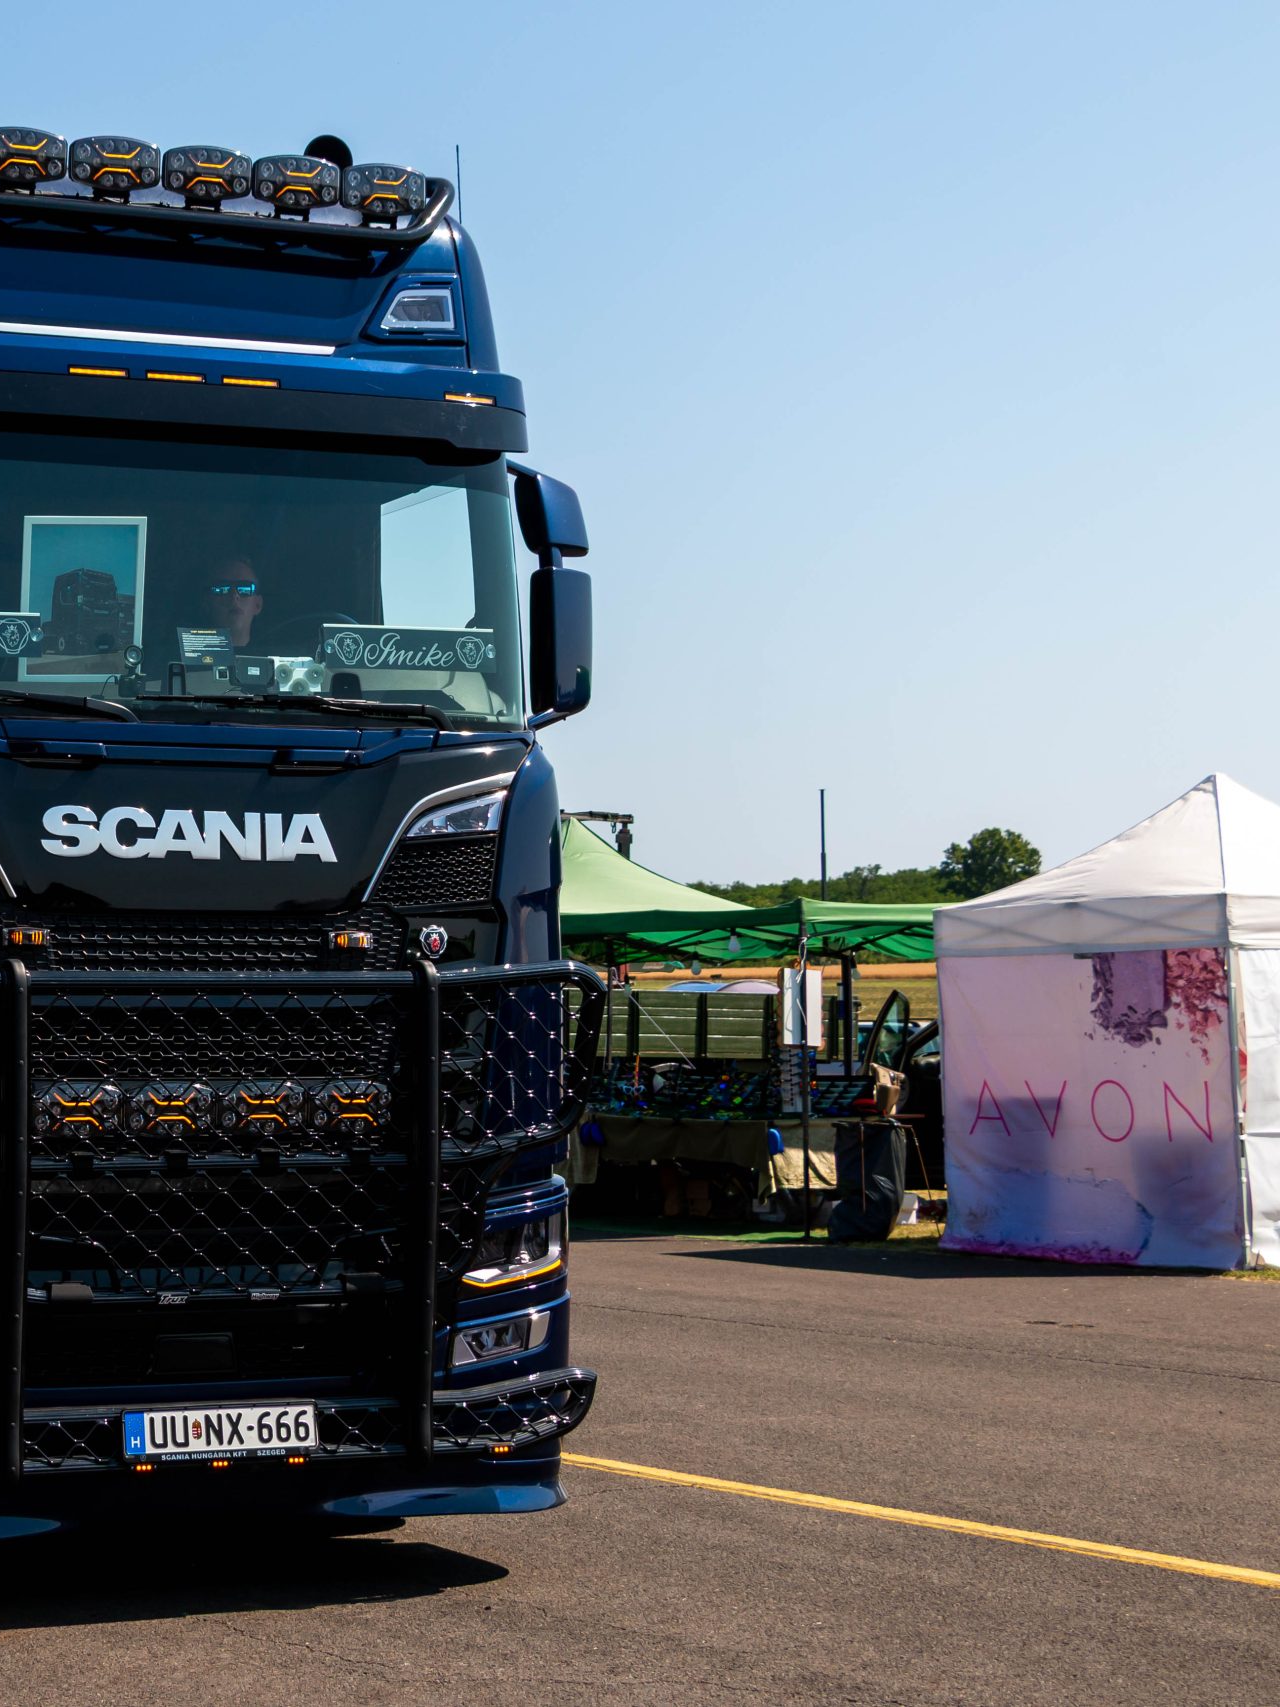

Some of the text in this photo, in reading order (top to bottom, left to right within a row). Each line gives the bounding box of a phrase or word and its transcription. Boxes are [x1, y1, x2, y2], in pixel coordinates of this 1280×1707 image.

[40, 804, 338, 863] SCANIA
[969, 1078, 1214, 1143] AVON
[158, 1293, 189, 1305] Trux
[130, 1436, 141, 1449] H
[161, 1453, 190, 1461] SCANIA
[233, 1450, 248, 1458] KFT
[257, 1448, 286, 1456] SZEGED
